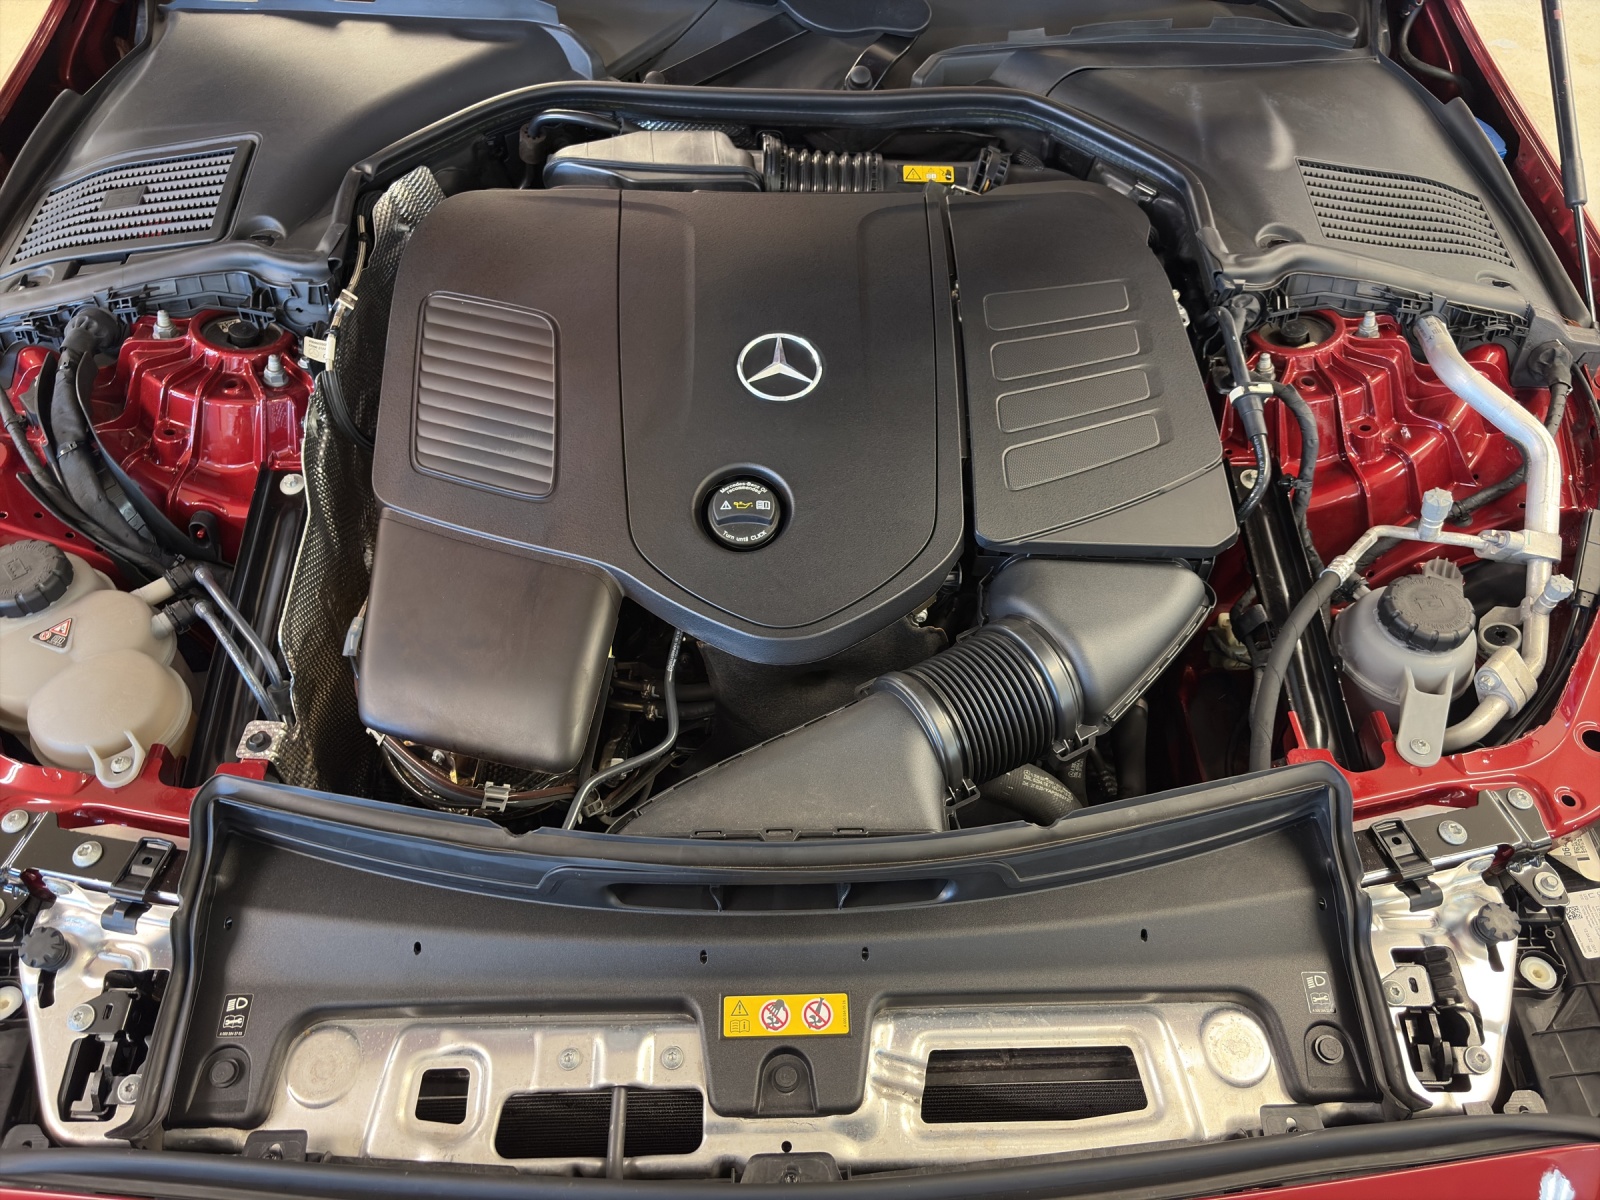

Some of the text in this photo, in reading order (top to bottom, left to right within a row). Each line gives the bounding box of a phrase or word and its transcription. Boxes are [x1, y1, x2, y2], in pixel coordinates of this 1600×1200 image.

[720, 482, 760, 494] Mercedes-Benz
[726, 485, 762, 494] recommended
[723, 530, 735, 540] Turn
[750, 530, 767, 541] CLICK
